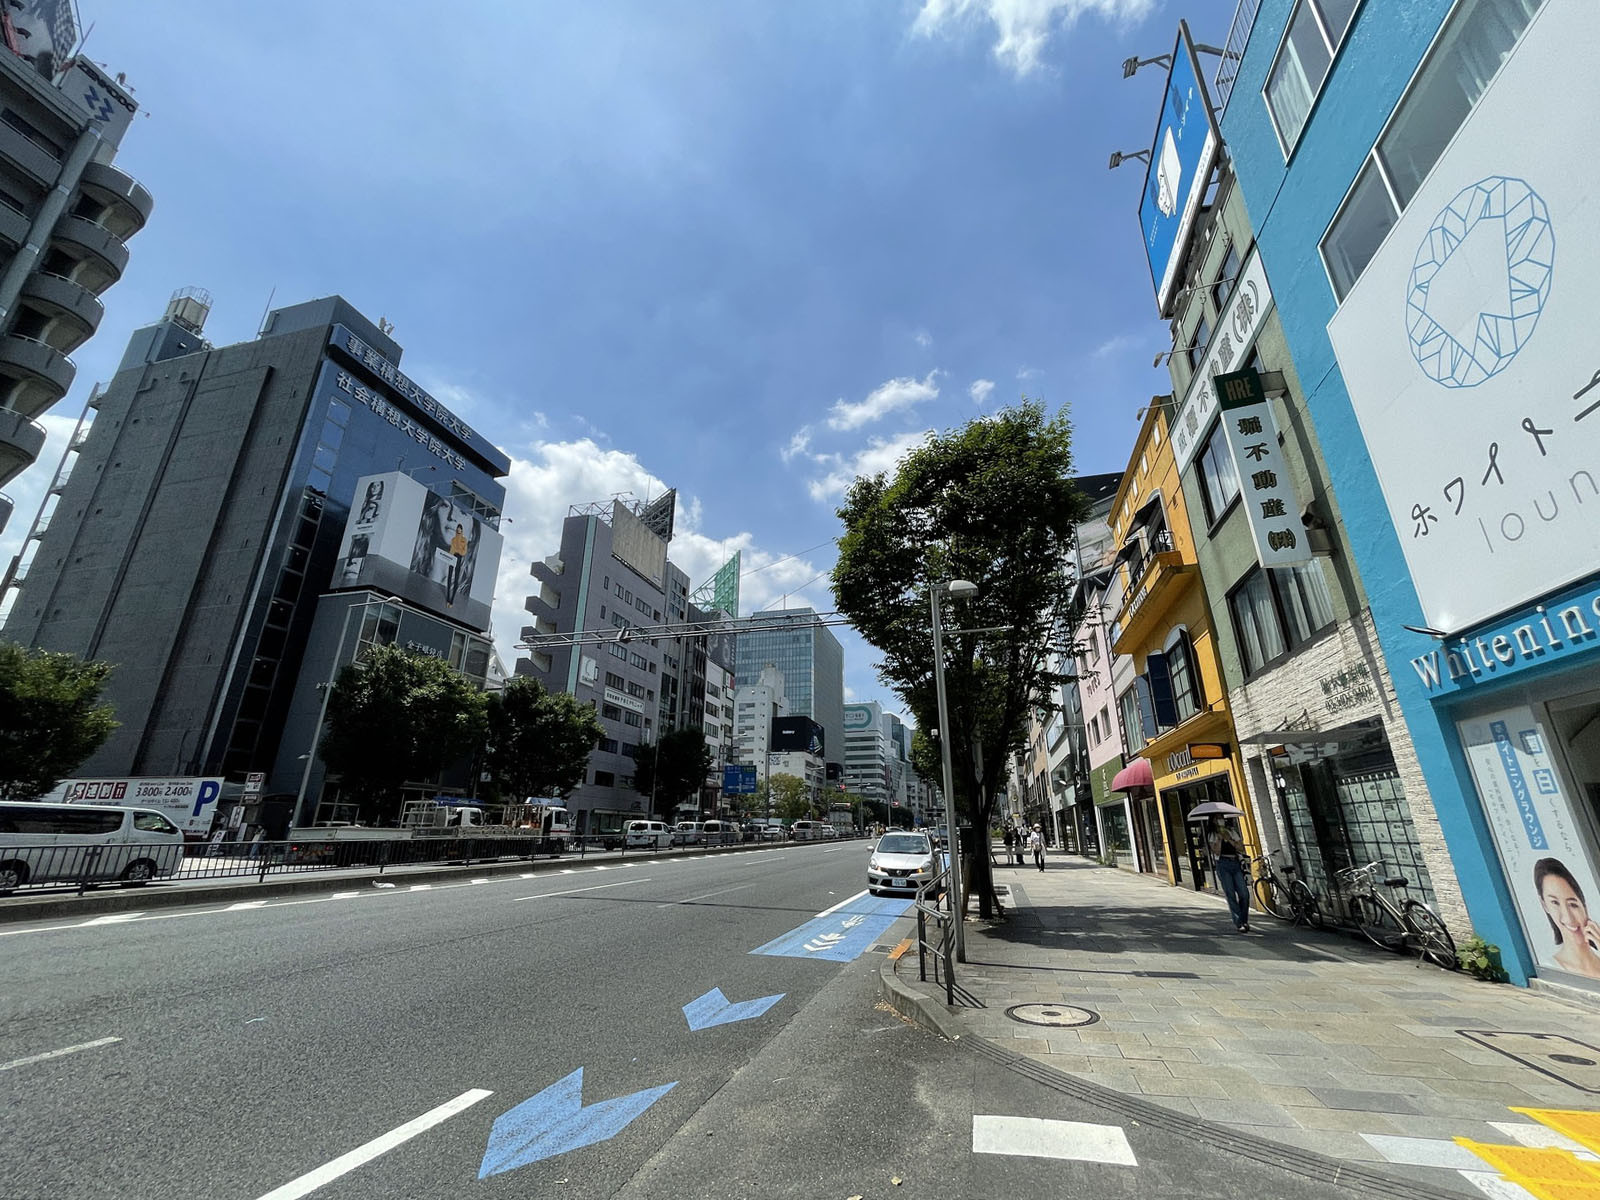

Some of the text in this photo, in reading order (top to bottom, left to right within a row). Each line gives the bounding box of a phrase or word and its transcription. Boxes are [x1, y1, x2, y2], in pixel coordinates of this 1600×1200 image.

[336, 371, 466, 471] 社会構想大学院大学
[346, 336, 472, 440] 事業構想大学院大学
[1225, 377, 1254, 401] HRE
[192, 780, 220, 817] P
